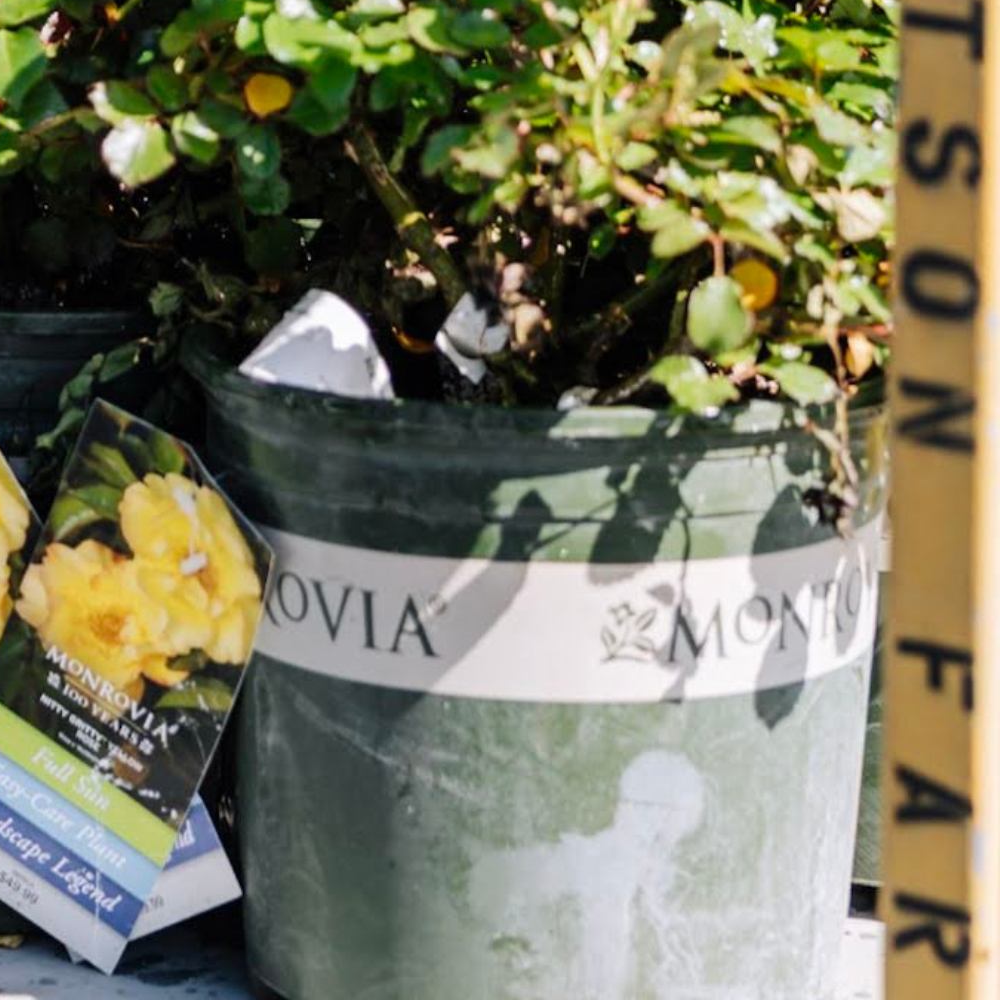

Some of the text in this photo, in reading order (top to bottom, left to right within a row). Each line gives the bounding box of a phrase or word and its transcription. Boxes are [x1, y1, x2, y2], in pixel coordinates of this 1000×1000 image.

[31, 746, 76, 783] Full
[72, 774, 110, 811] Sun
[76, 822, 127, 868] Plant
[51, 854, 123, 912] Legend
